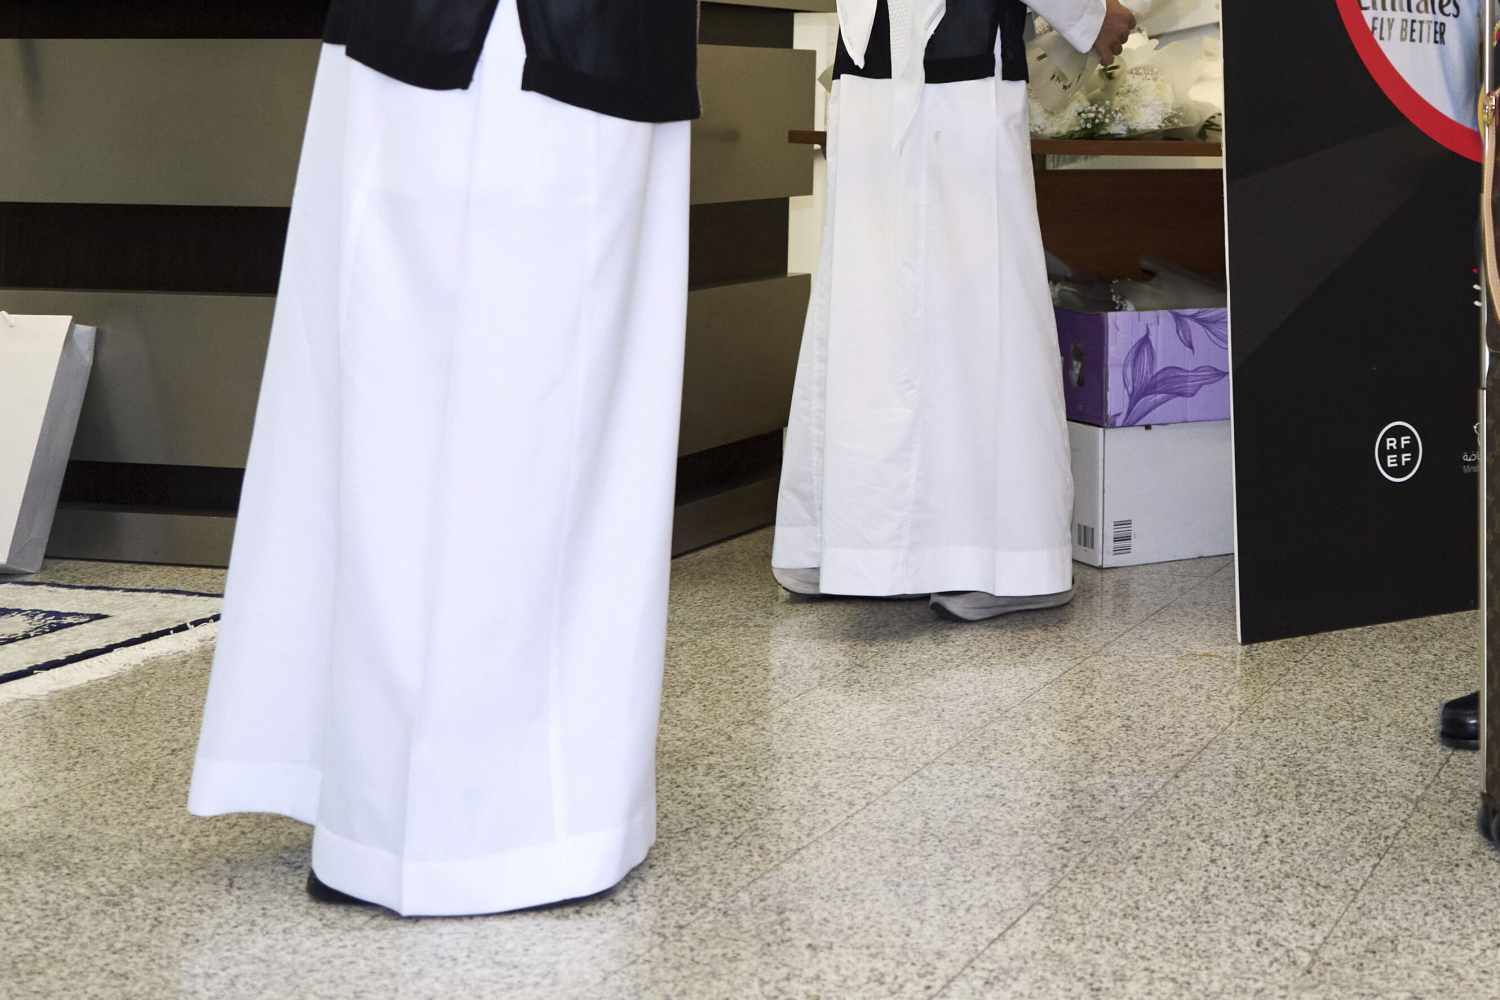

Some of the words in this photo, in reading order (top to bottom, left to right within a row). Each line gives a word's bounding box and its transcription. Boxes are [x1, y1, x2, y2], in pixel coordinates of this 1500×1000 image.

[1371, 17, 1395, 41] FLY
[1400, 18, 1446, 45] BETTER
[1386, 436, 1411, 450] RF
[1387, 453, 1412, 467] EF
